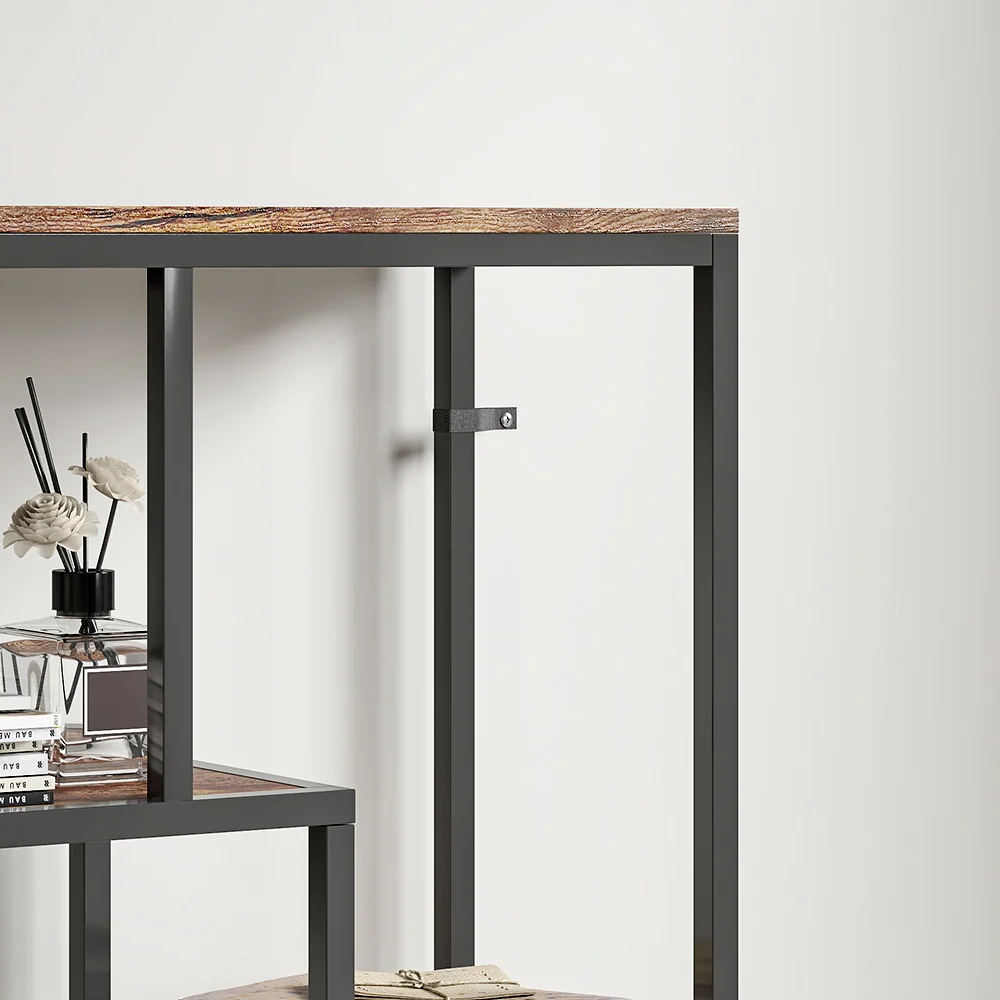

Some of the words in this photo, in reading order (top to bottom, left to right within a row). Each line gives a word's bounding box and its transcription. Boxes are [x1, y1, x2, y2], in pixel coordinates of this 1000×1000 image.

[15, 730, 33, 738] BAU
[0, 742, 16, 750] BAU
[3, 762, 20, 770] BAU
[9, 781, 27, 789] BAU
[9, 795, 27, 804] BAU
